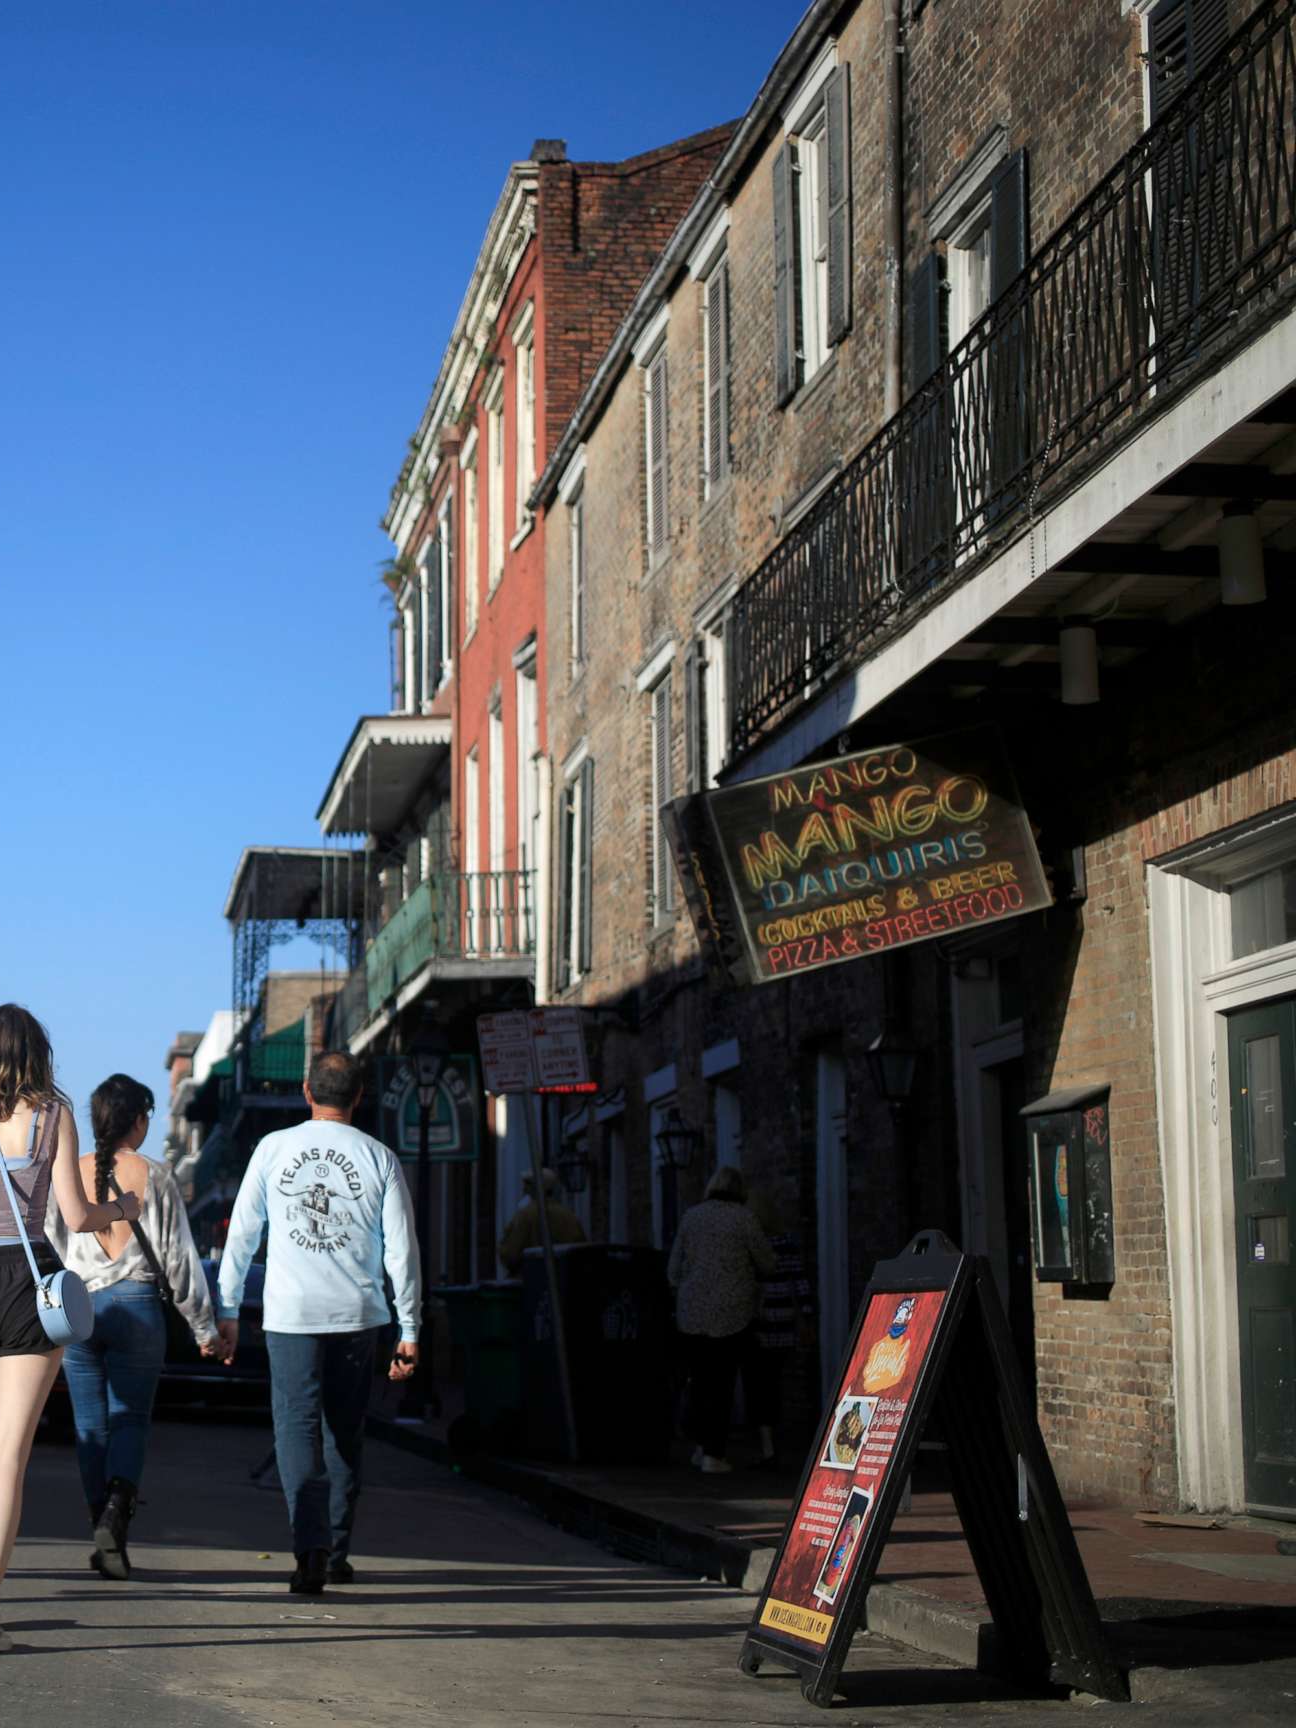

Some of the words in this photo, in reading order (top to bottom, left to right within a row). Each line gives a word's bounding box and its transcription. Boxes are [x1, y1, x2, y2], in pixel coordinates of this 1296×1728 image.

[769, 747, 917, 813] MANGO
[740, 774, 988, 890] MANGO
[757, 895, 887, 945] COCKTAILS
[895, 885, 919, 909] &
[930, 861, 1016, 901] BEER
[765, 830, 986, 911] DAIQUIRIS
[768, 934, 841, 973] PIZZA
[841, 928, 861, 956] &
[280, 1148, 320, 1187] TEJAS
[324, 1149, 362, 1192] RODEO
[289, 1229, 352, 1254] COMPANY
